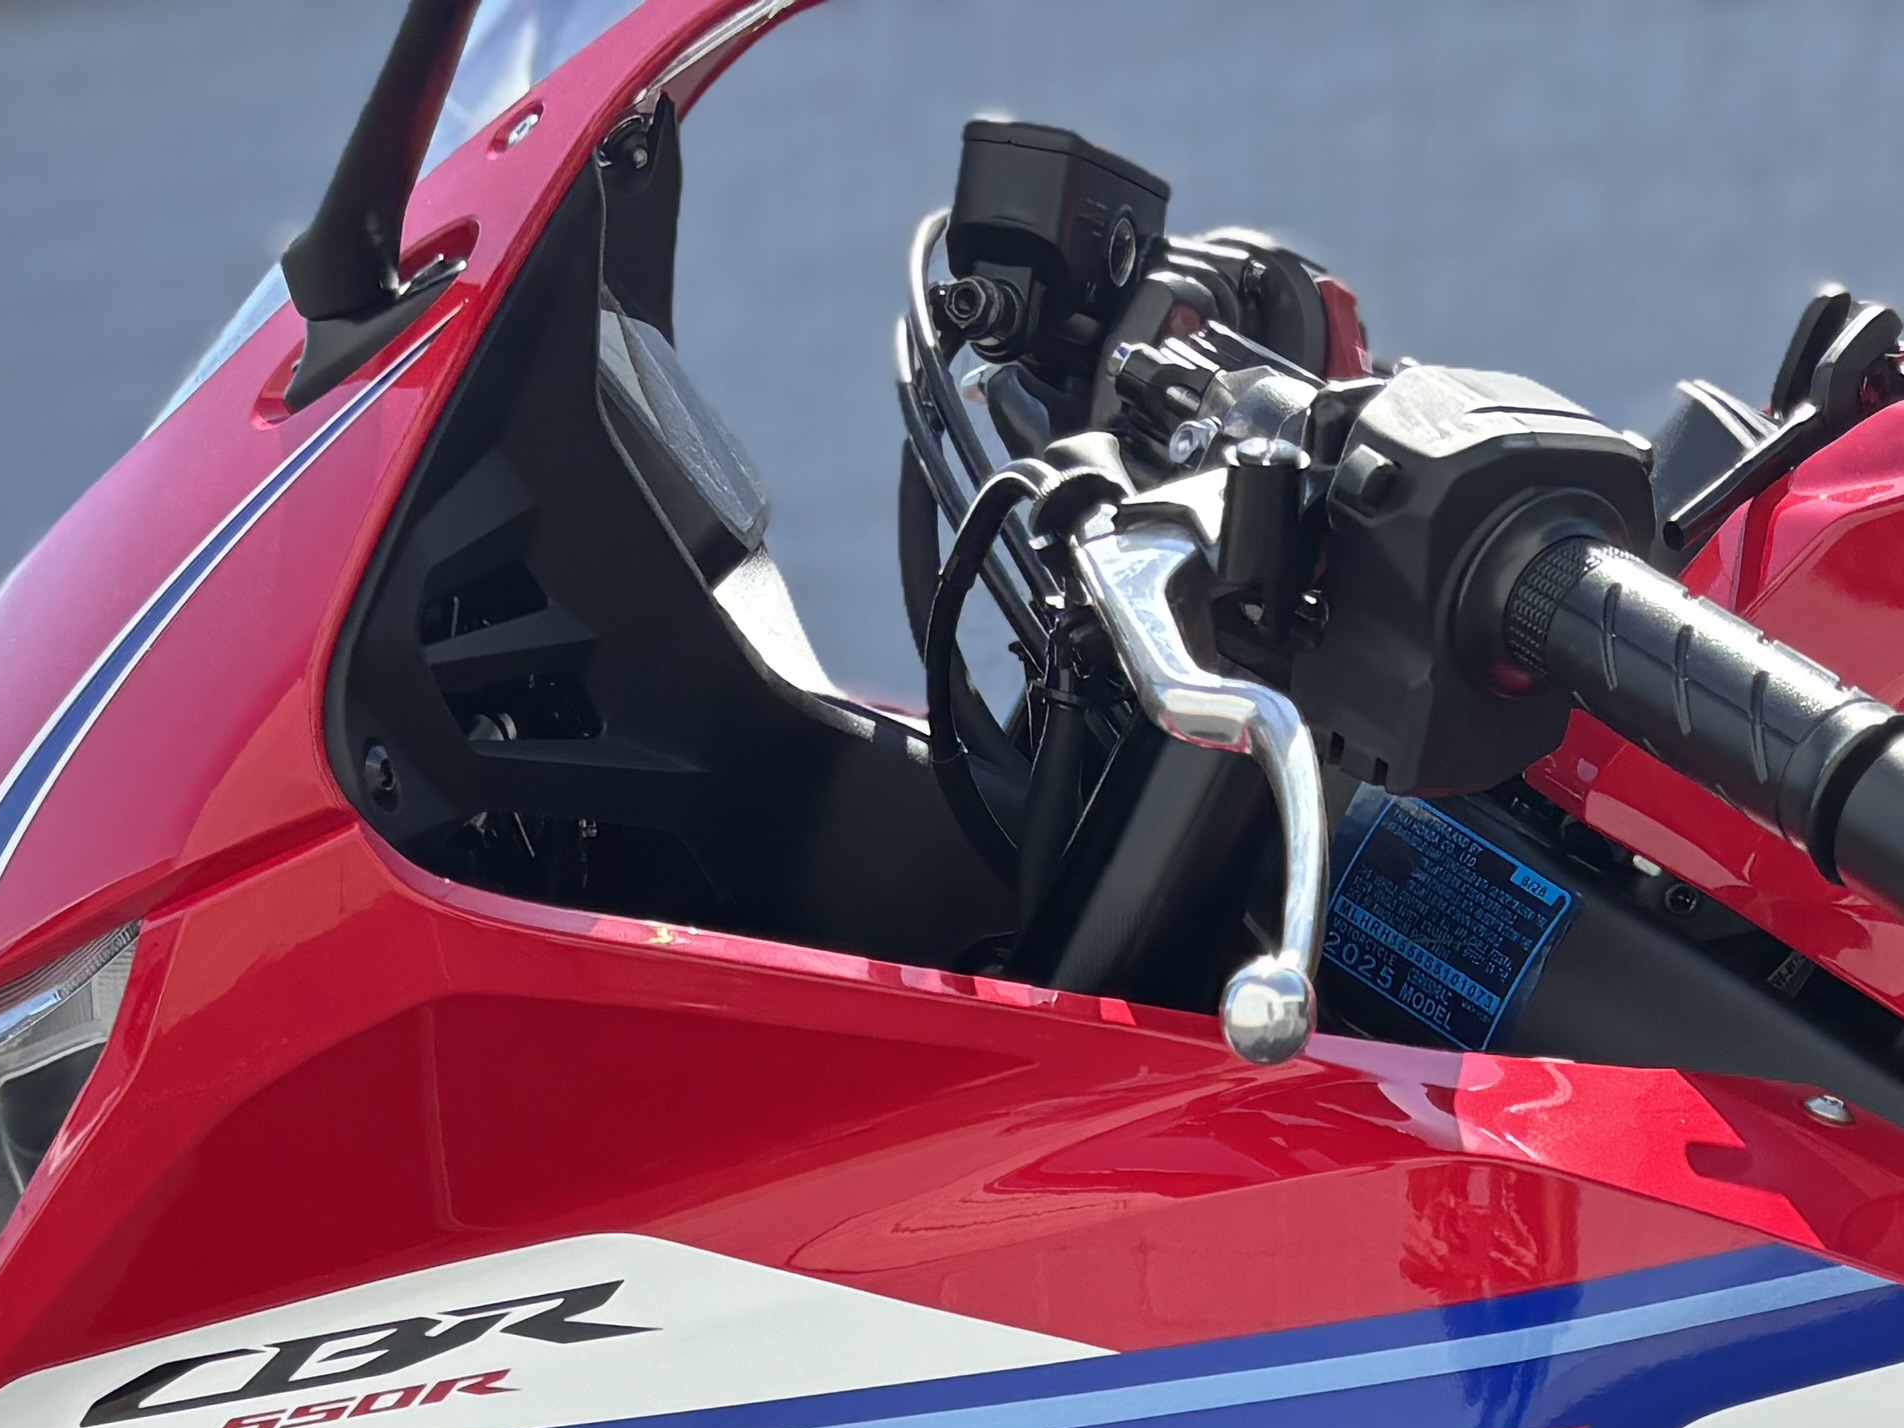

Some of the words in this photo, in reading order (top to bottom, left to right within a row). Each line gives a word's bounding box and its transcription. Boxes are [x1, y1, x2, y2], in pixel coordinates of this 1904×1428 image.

[1324, 932, 1393, 990] 2025
[1399, 983, 1452, 1030] MODEL
[1332, 917, 1397, 967] MOTORCYCLE
[80, 1279, 663, 1428] CBR
